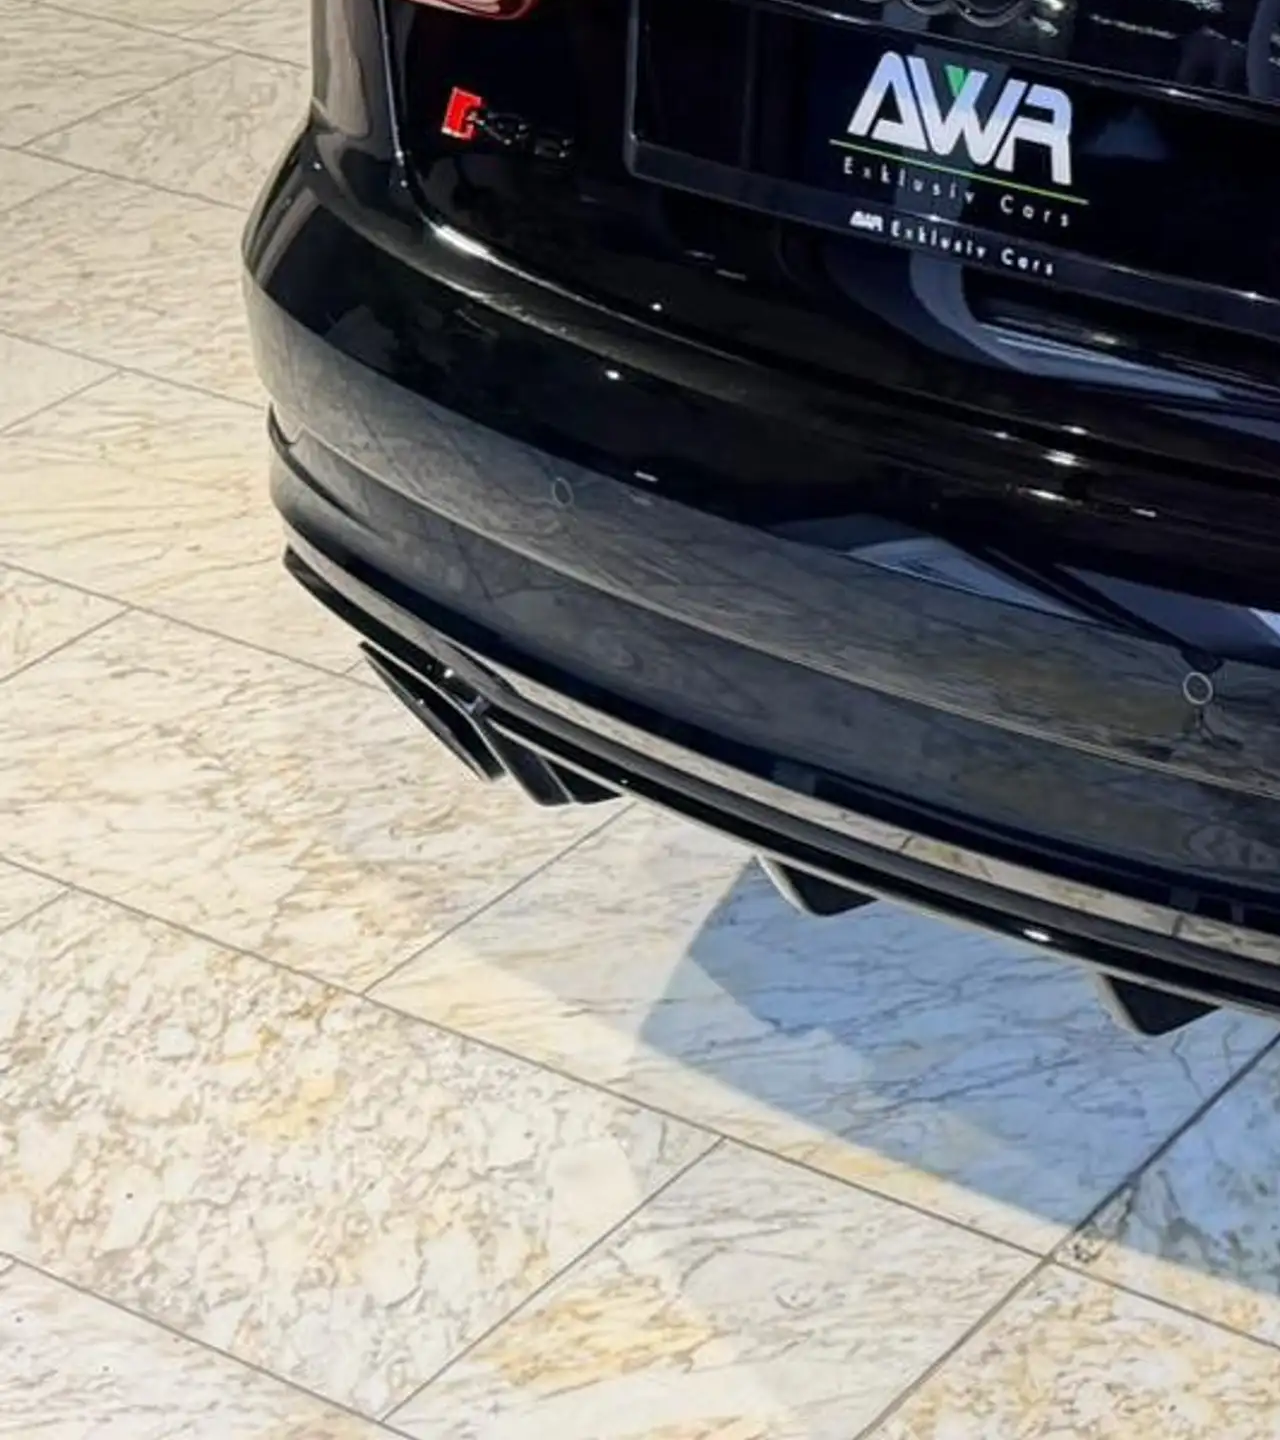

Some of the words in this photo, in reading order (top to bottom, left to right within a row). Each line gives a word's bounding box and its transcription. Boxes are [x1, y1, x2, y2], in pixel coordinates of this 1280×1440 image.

[847, 50, 1073, 186] AWR
[843, 156, 975, 204] Exklusiv
[1000, 194, 1070, 228] Cars
[890, 220, 987, 259] Exklusiv
